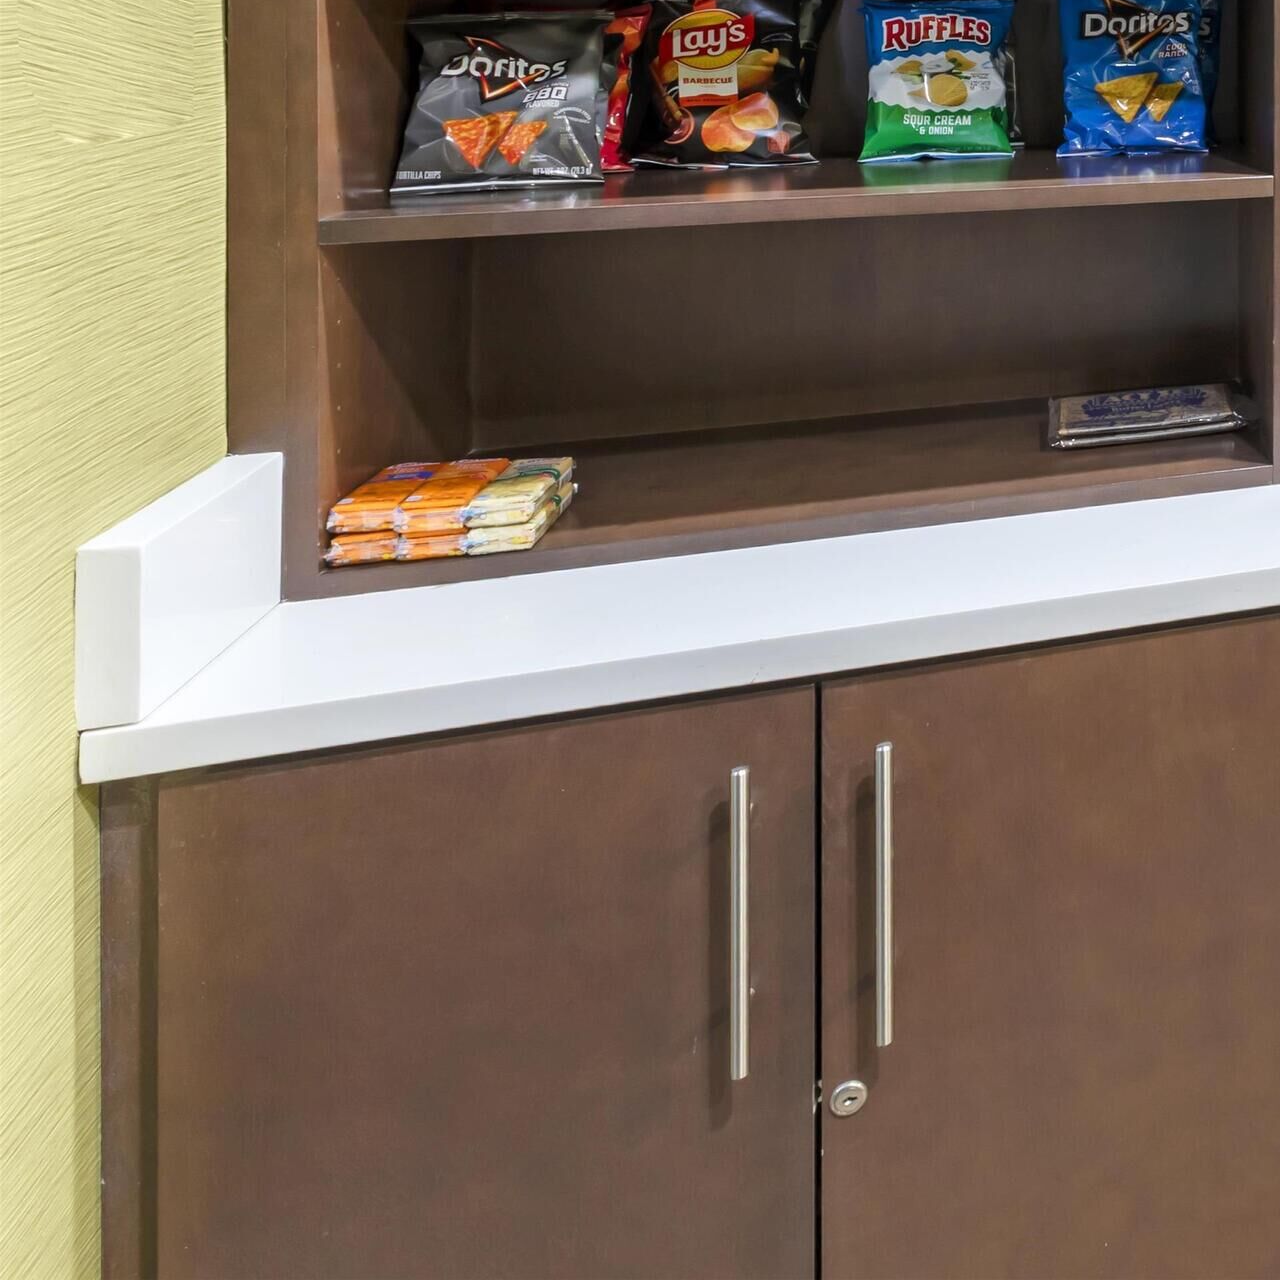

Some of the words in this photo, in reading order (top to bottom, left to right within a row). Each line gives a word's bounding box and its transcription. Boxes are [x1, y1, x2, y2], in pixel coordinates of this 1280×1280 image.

[884, 15, 990, 50] RUFFLES
[1084, 12, 1190, 37] Doritos
[672, 20, 746, 59] Lay's
[1166, 43, 1187, 52] COOL
[440, 56, 568, 82] Doritos
[683, 76, 733, 85] BARBECUE
[523, 86, 568, 103] BBQ
[903, 114, 931, 128] SOUR
[934, 115, 972, 125] CREAM
[928, 127, 954, 135] ONION
